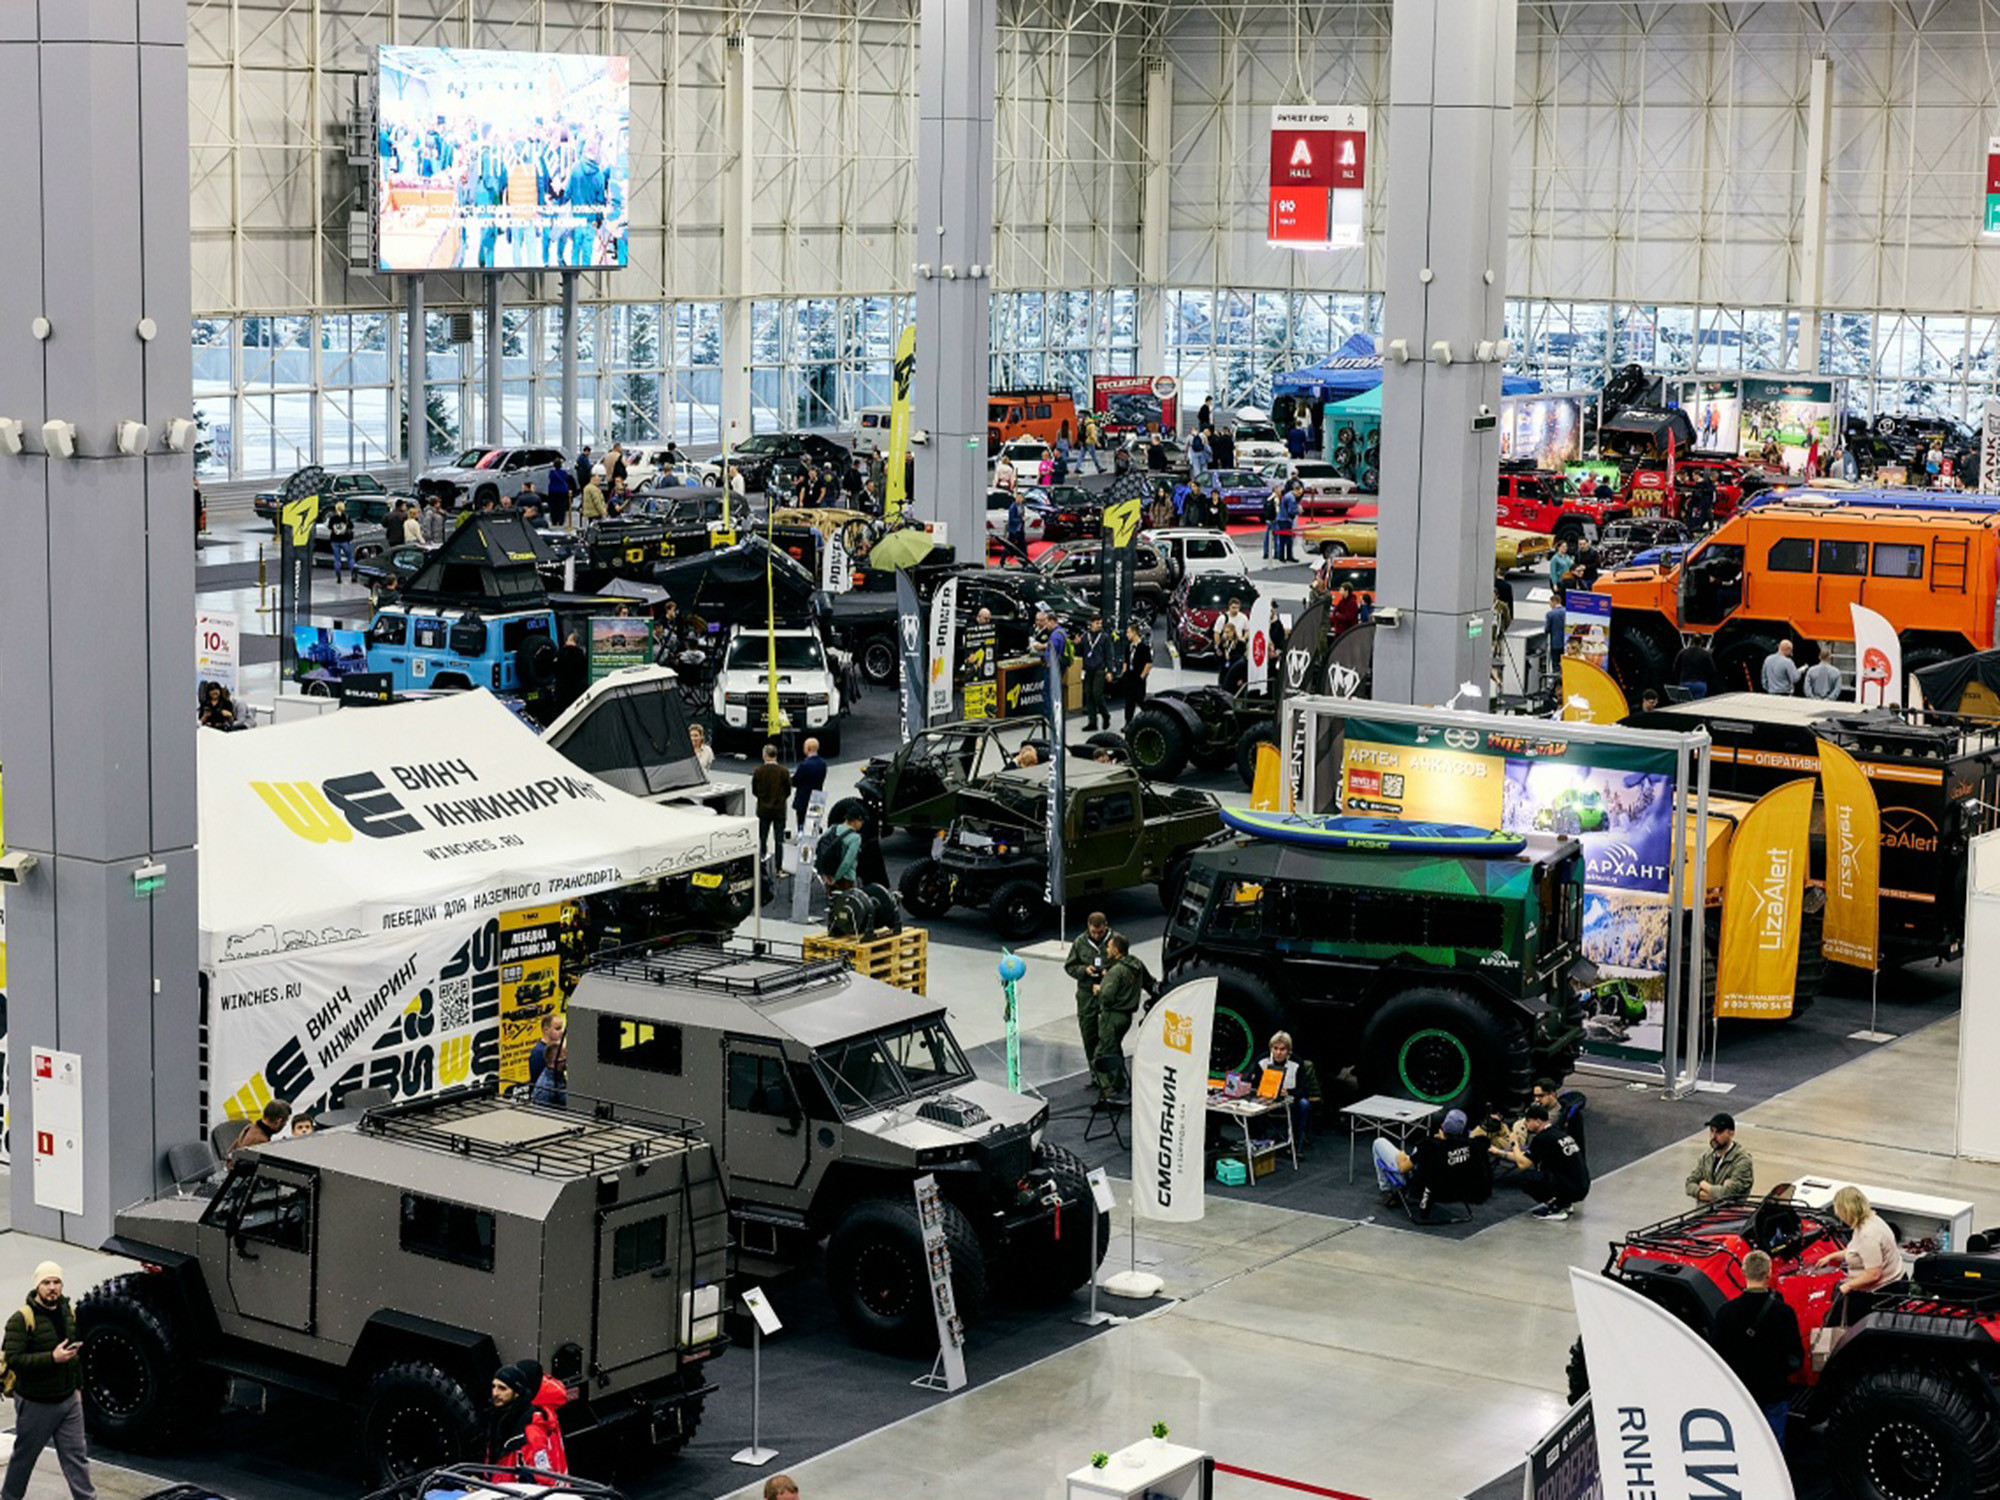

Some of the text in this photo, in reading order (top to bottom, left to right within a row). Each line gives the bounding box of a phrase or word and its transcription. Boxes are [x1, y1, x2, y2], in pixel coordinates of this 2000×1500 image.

[1290, 139, 1312, 165] A
[390, 758, 477, 793] ВИНЧ
[423, 834, 525, 862] WINCHES.RU
[1587, 859, 1665, 880] АРХАНТ
[382, 866, 624, 930] ЛЕБЕДКИ ДЛЯ НАЗЕМНОГО ТРАНСПОРТА
[1759, 848, 1789, 950] LizaAlert
[221, 983, 302, 1011] WINCHES.RU
[306, 985, 353, 1043] ВИНЧ
[318, 952, 420, 1070] ИНЖИНИРИНГ
[1158, 1066, 1178, 1208] СМОЛЯНИН
